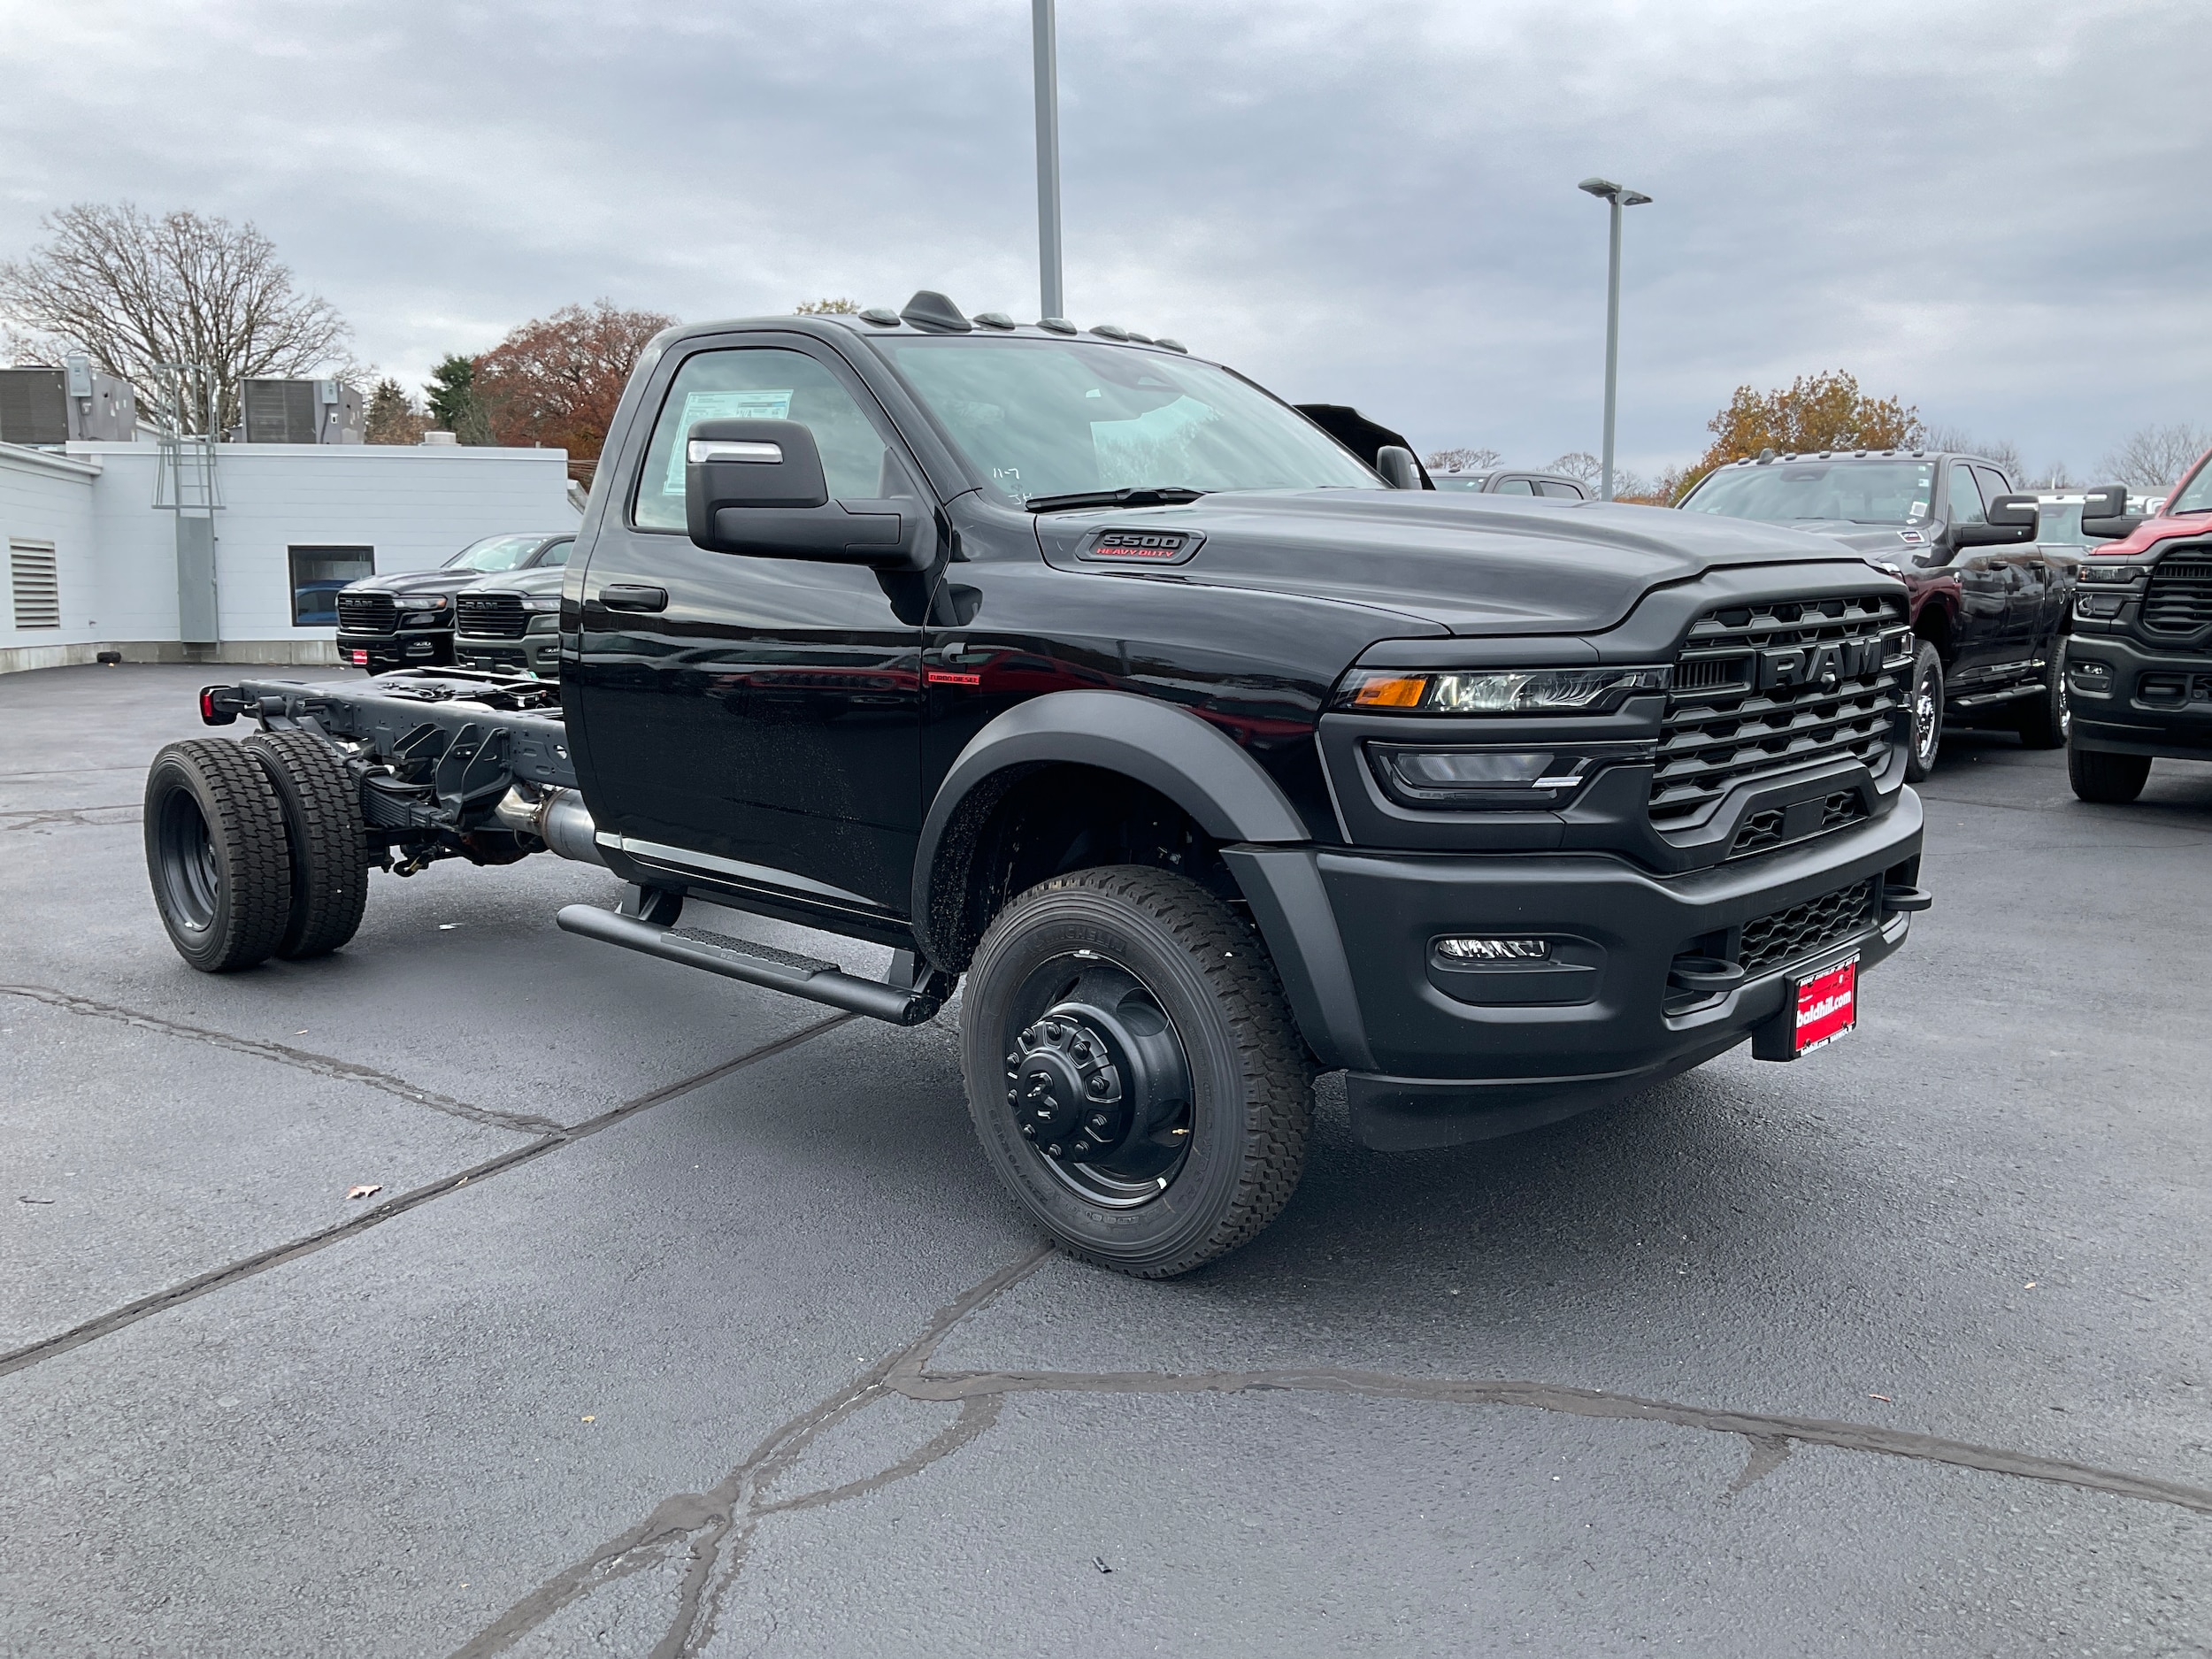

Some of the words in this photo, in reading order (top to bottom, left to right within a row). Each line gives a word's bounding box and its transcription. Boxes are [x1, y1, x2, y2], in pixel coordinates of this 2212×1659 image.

[1102, 534, 1182, 549] 5500
[1138, 549, 1175, 558] DUTY
[465, 602, 499, 611] RAM
[1760, 637, 1883, 690] RAM
[1795, 990, 1852, 1029] baldhill.com
